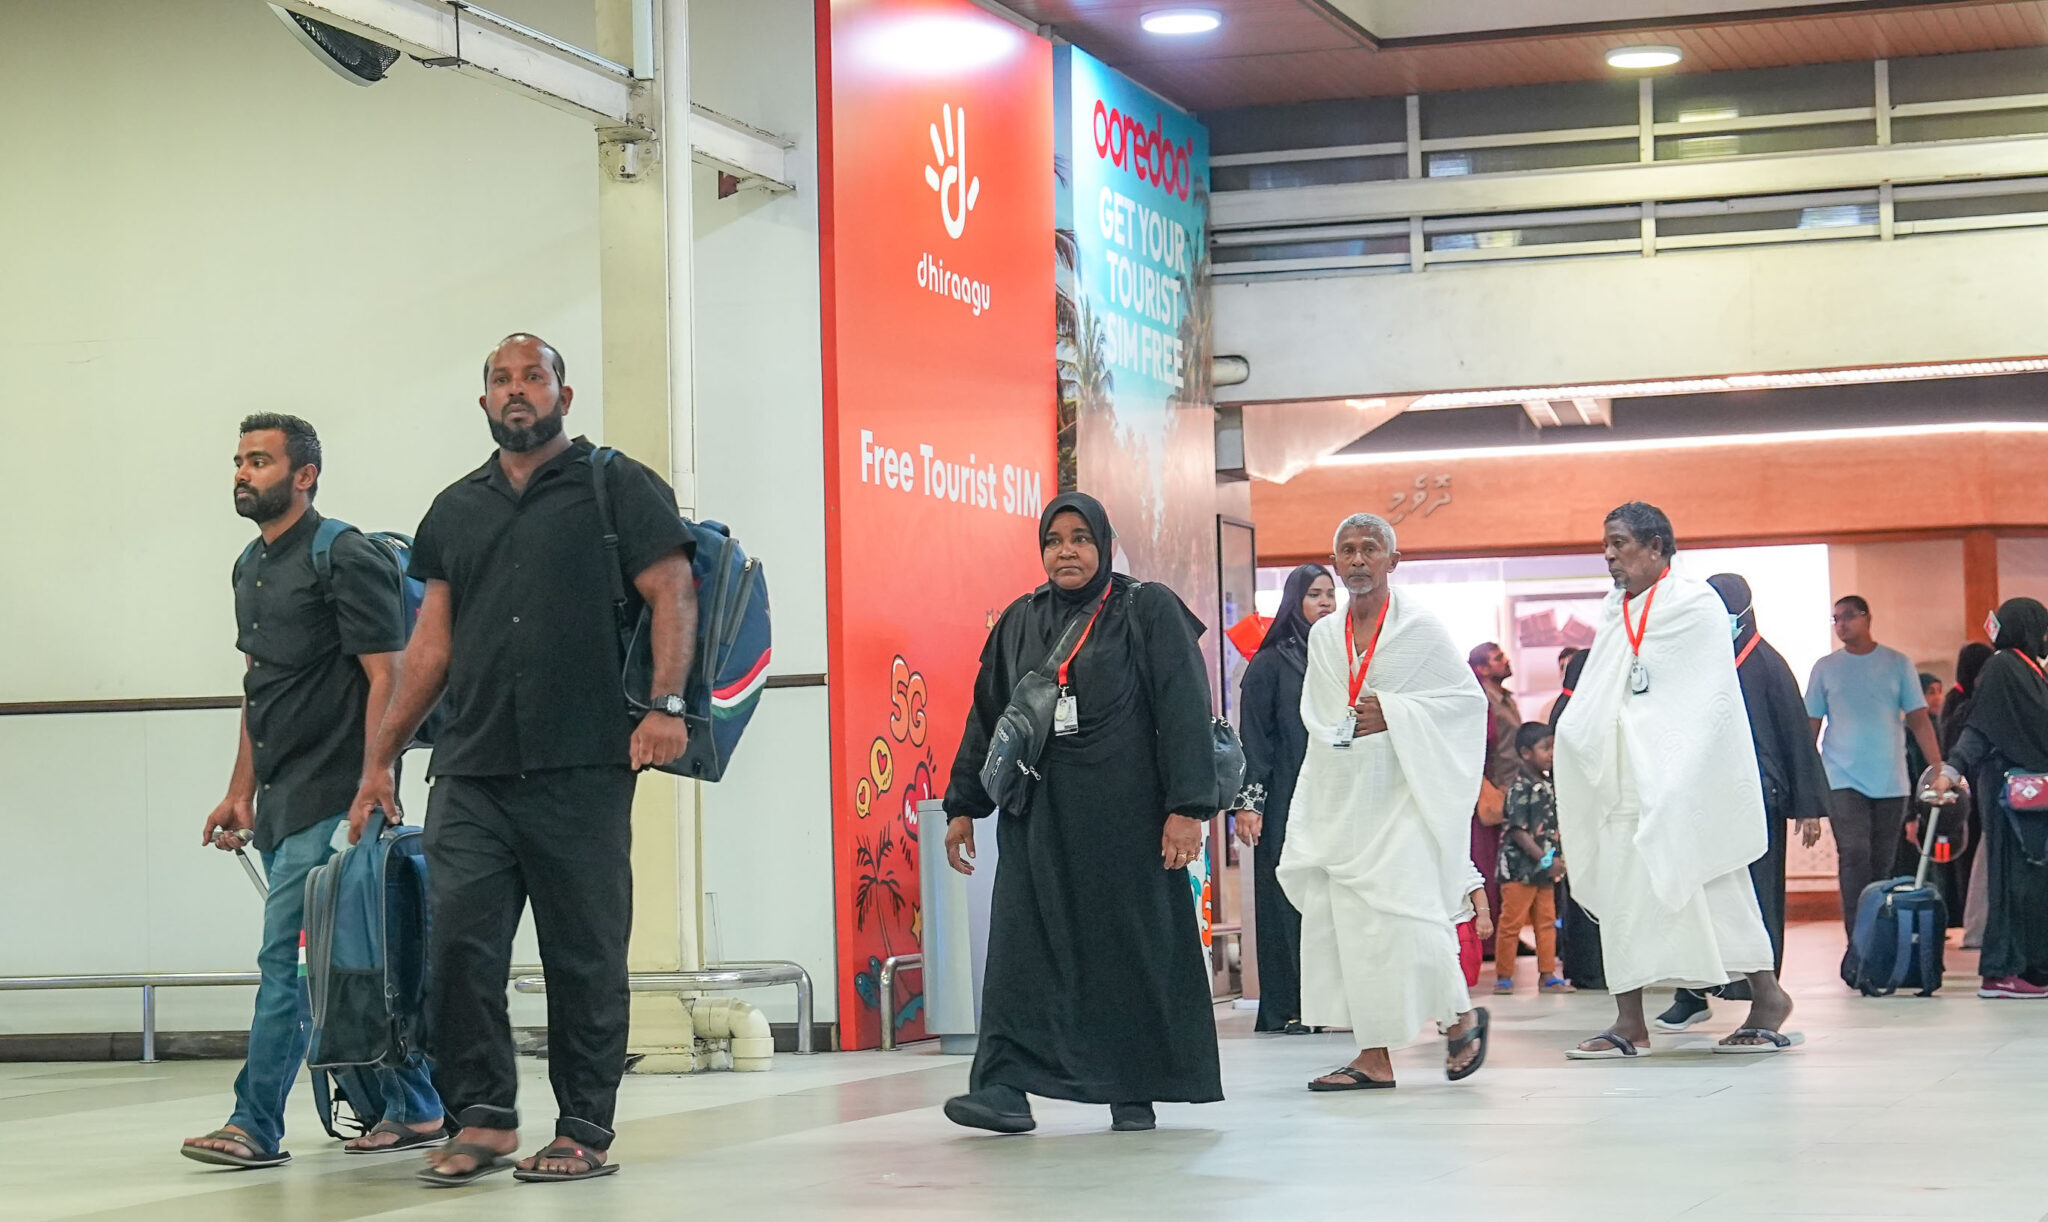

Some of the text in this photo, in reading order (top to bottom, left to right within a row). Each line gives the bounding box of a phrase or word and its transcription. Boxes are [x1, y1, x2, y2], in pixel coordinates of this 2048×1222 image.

[1094, 99, 1191, 201] ooredoo
[1100, 186, 1184, 272] GET YOUR
[917, 252, 990, 316] dhiraagu
[1106, 250, 1181, 328] TOURIST
[1105, 312, 1184, 388] SIM FREE
[861, 429, 1042, 519] Free Tourist SIM
[890, 654, 927, 747] 5G
